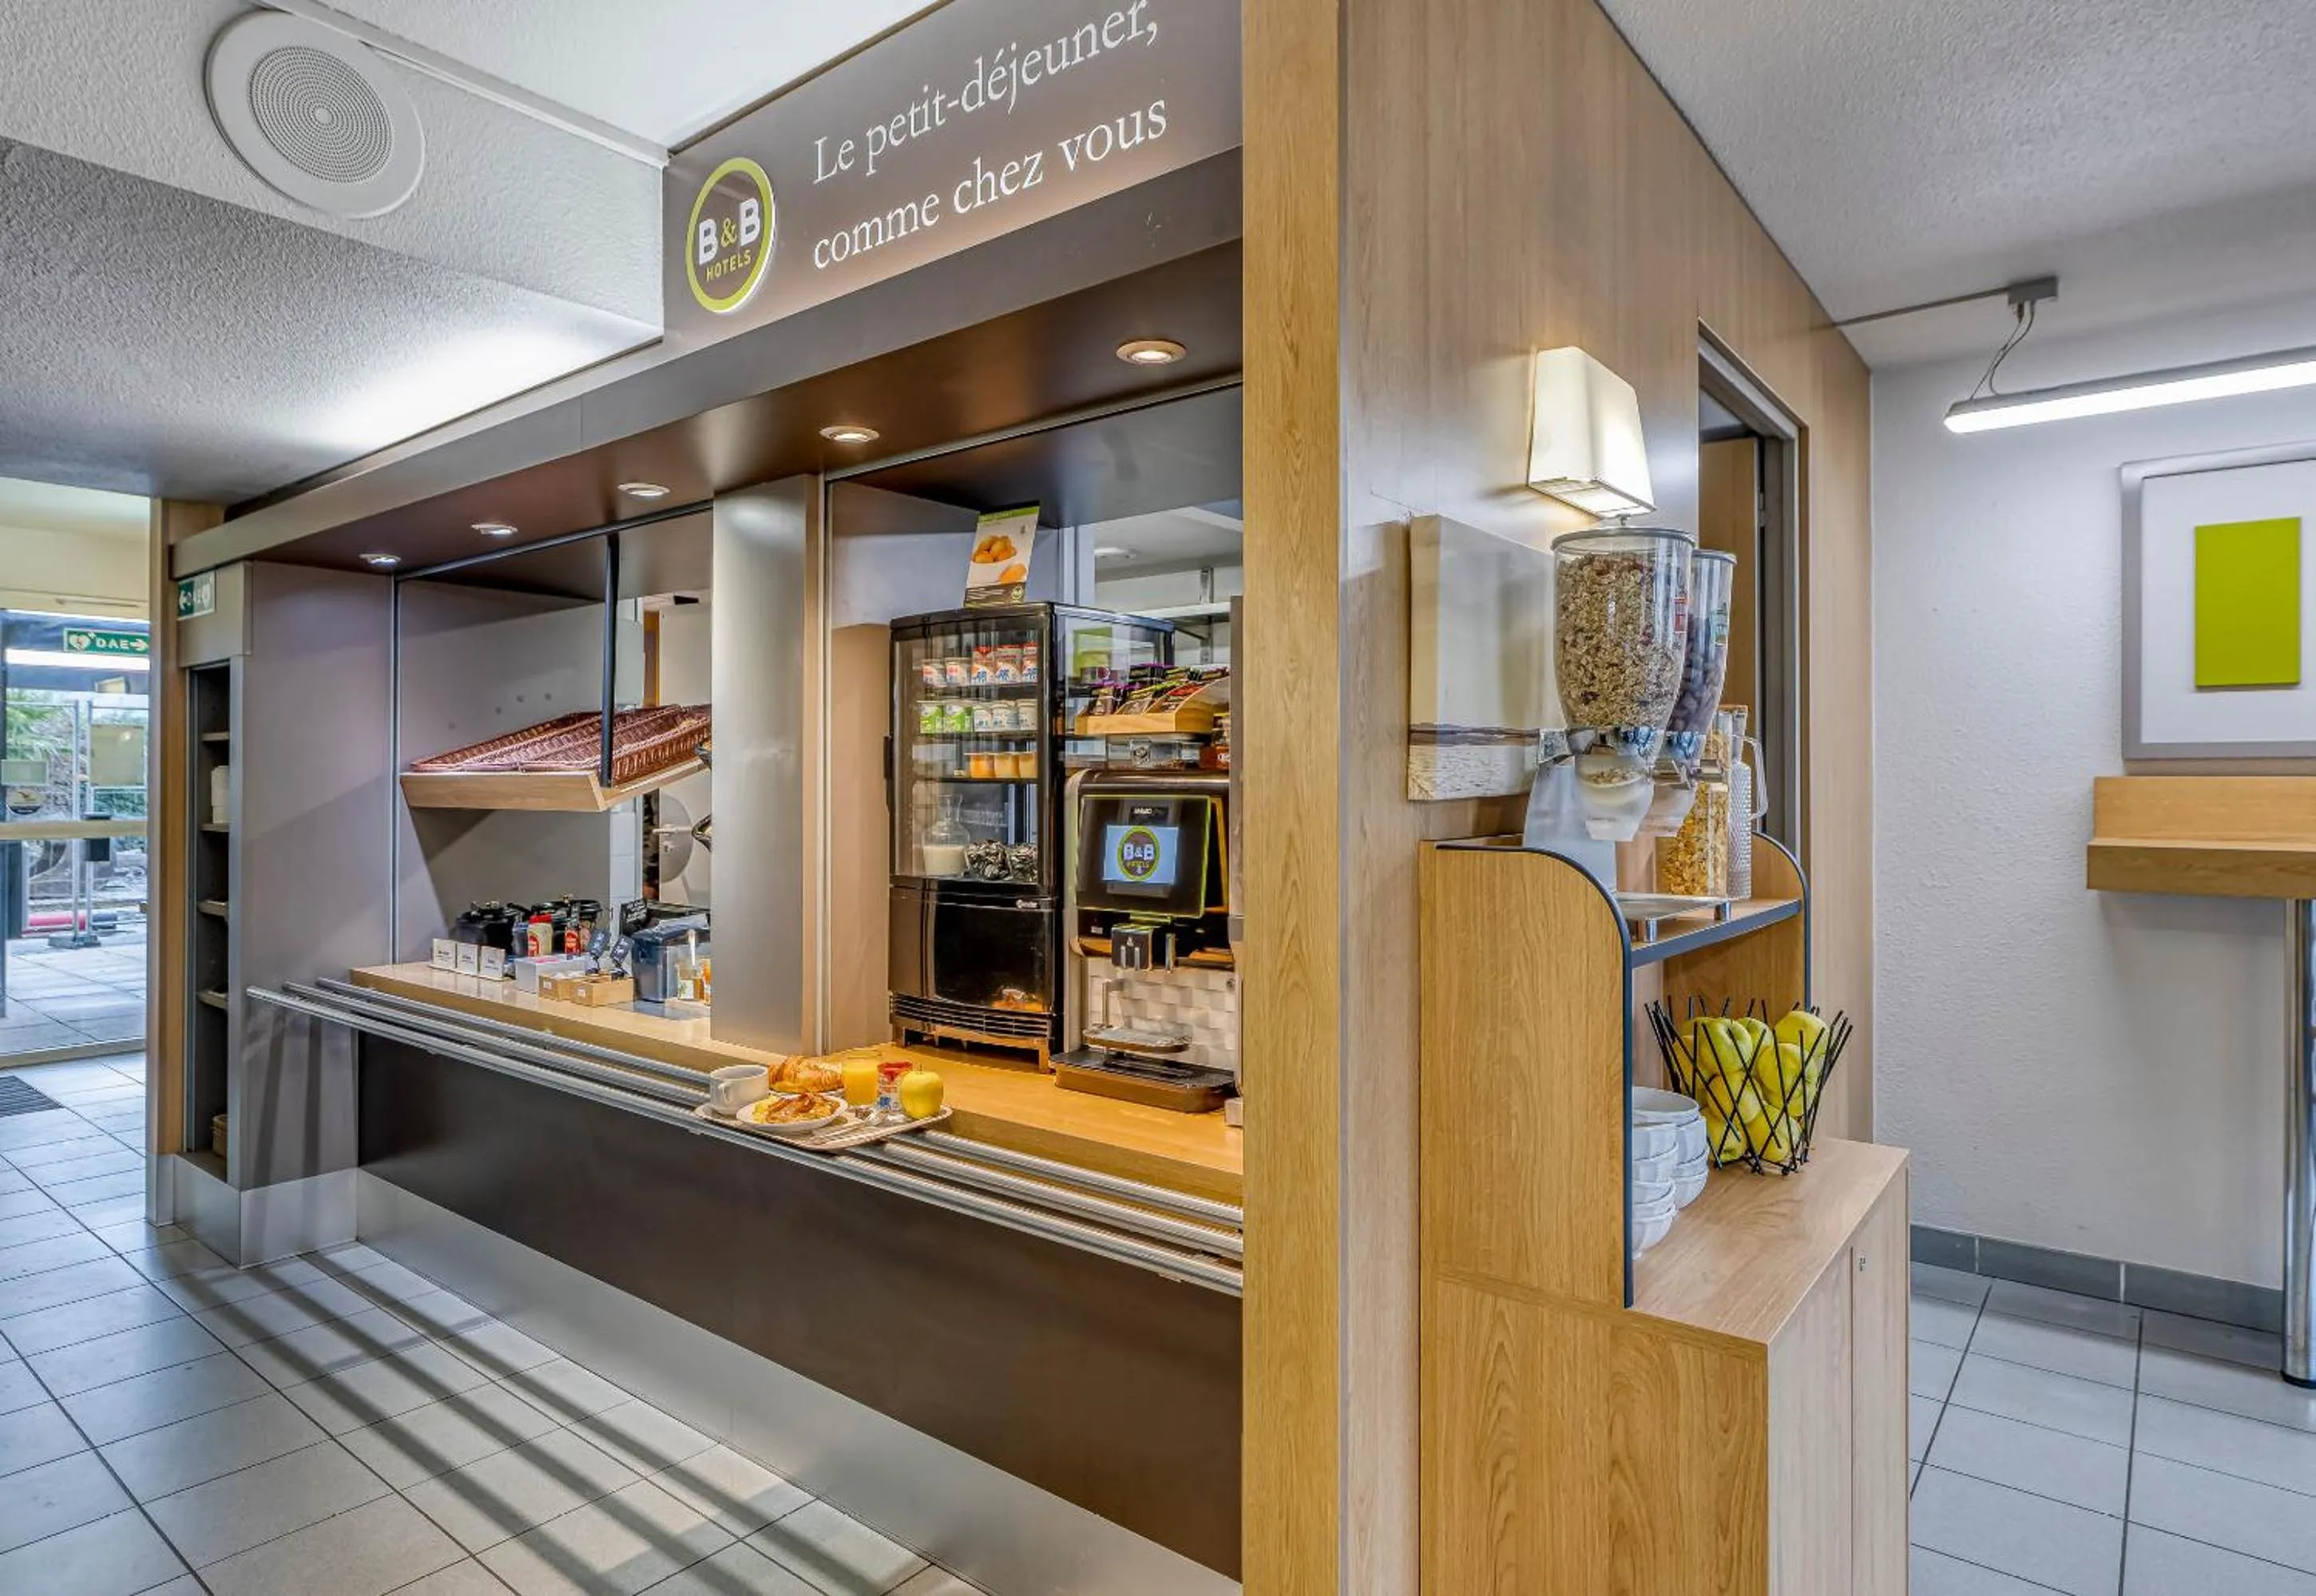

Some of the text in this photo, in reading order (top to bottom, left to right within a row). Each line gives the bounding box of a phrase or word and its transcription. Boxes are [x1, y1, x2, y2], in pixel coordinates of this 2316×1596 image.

[812, 0, 1160, 185] Le petit-déjeuner,
[814, 98, 1168, 270] comme chez vous
[699, 198, 760, 265] B&B
[706, 249, 752, 282] HOTELS
[95, 636, 129, 649] DAE
